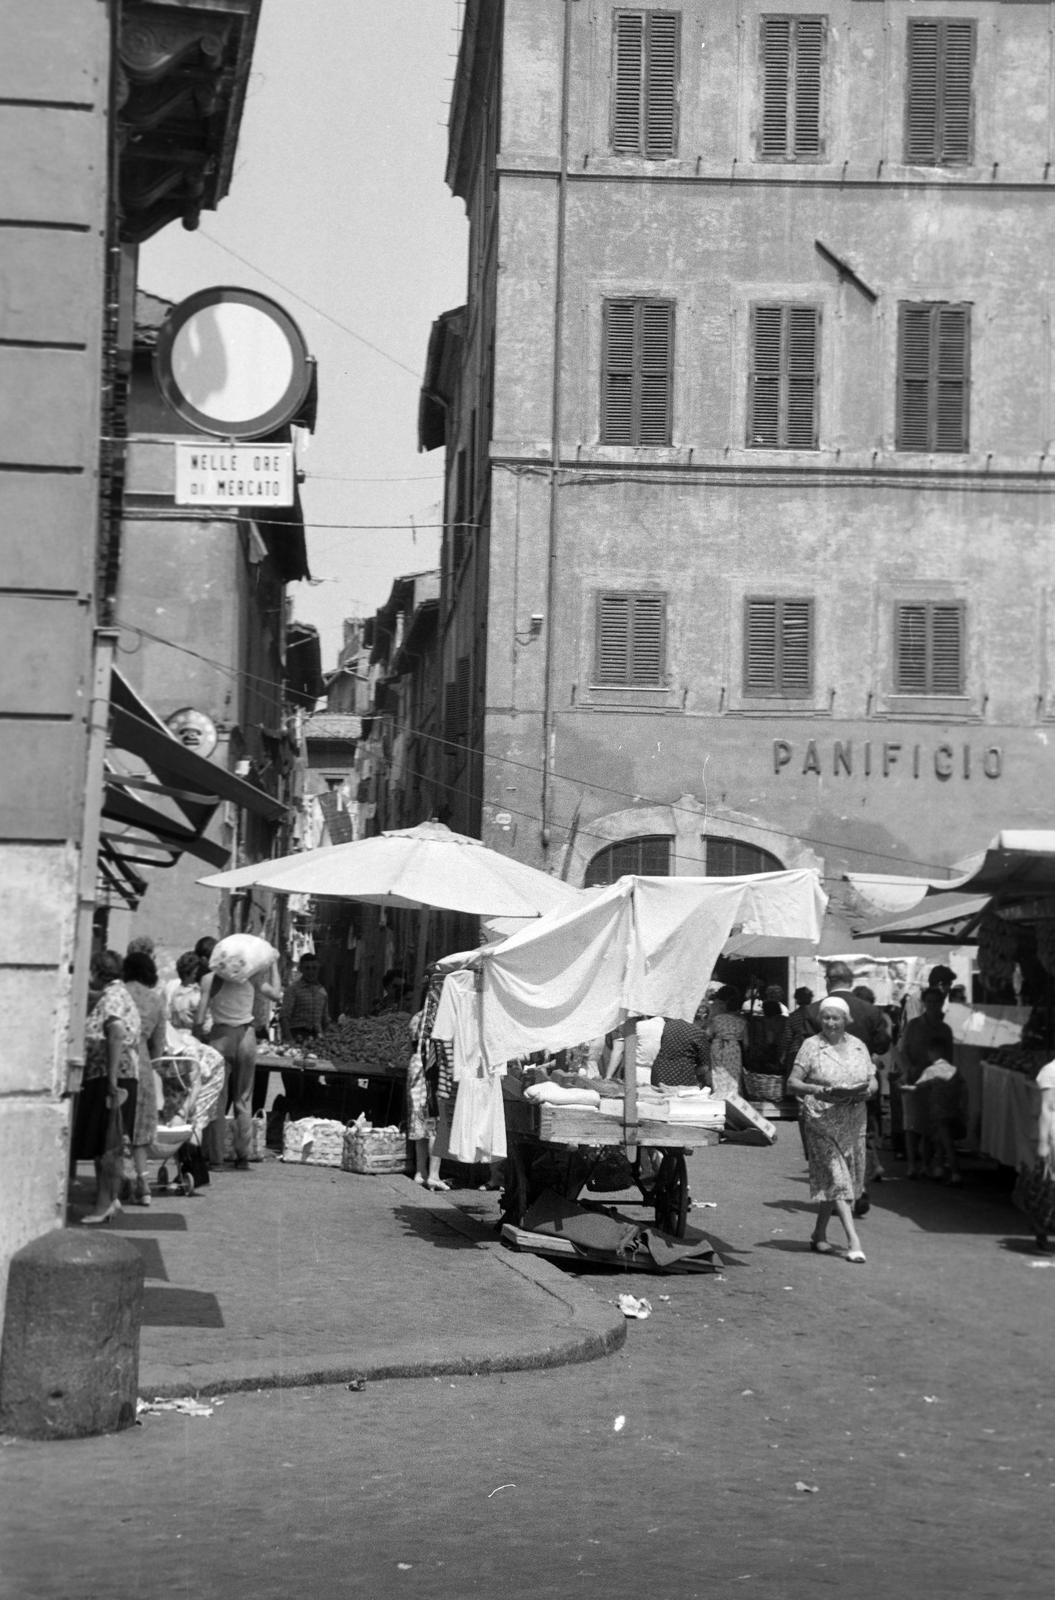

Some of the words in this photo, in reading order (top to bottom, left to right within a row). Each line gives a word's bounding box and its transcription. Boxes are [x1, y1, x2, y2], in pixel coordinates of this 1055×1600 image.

[254, 456, 280, 472] ORE
[191, 483, 204, 495] DI
[217, 480, 279, 496] MERCATO
[772, 738, 1002, 782] PANIFICIO
